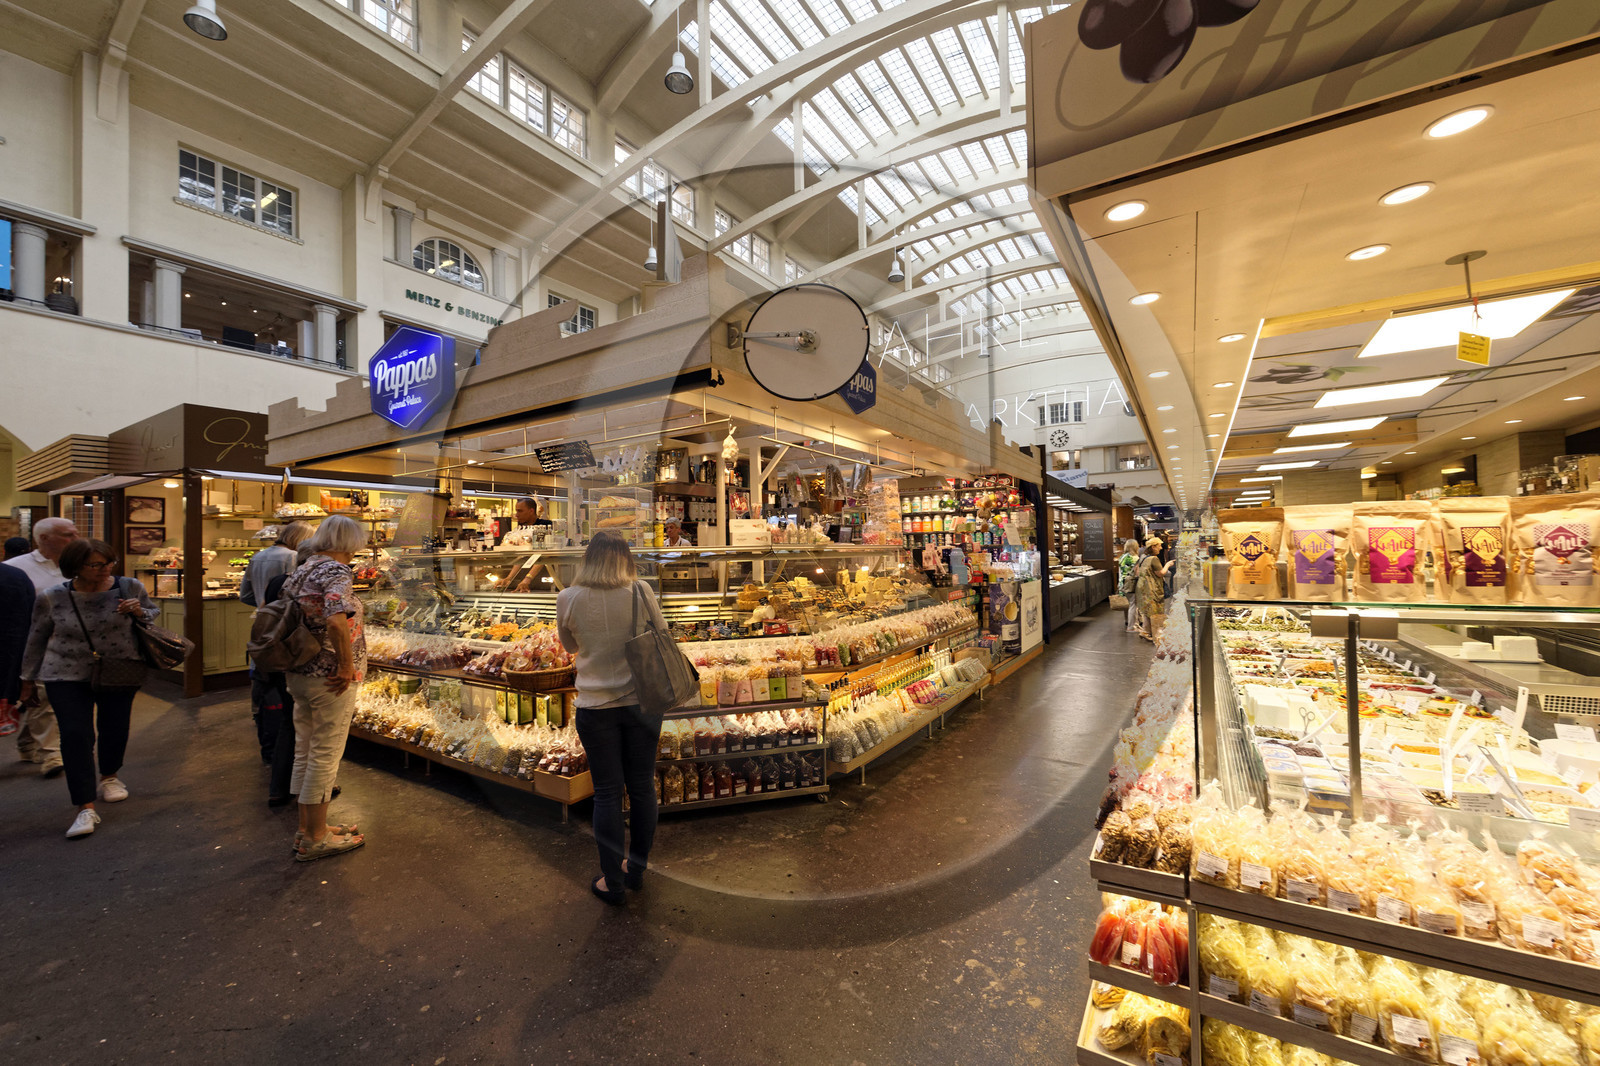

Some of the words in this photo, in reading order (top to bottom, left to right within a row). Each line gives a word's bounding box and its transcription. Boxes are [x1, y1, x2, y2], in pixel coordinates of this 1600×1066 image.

[405, 289, 441, 309] MERZ
[444, 302, 454, 312] &
[866, 288, 1049, 368] AHRE
[374, 353, 437, 399] Pappas
